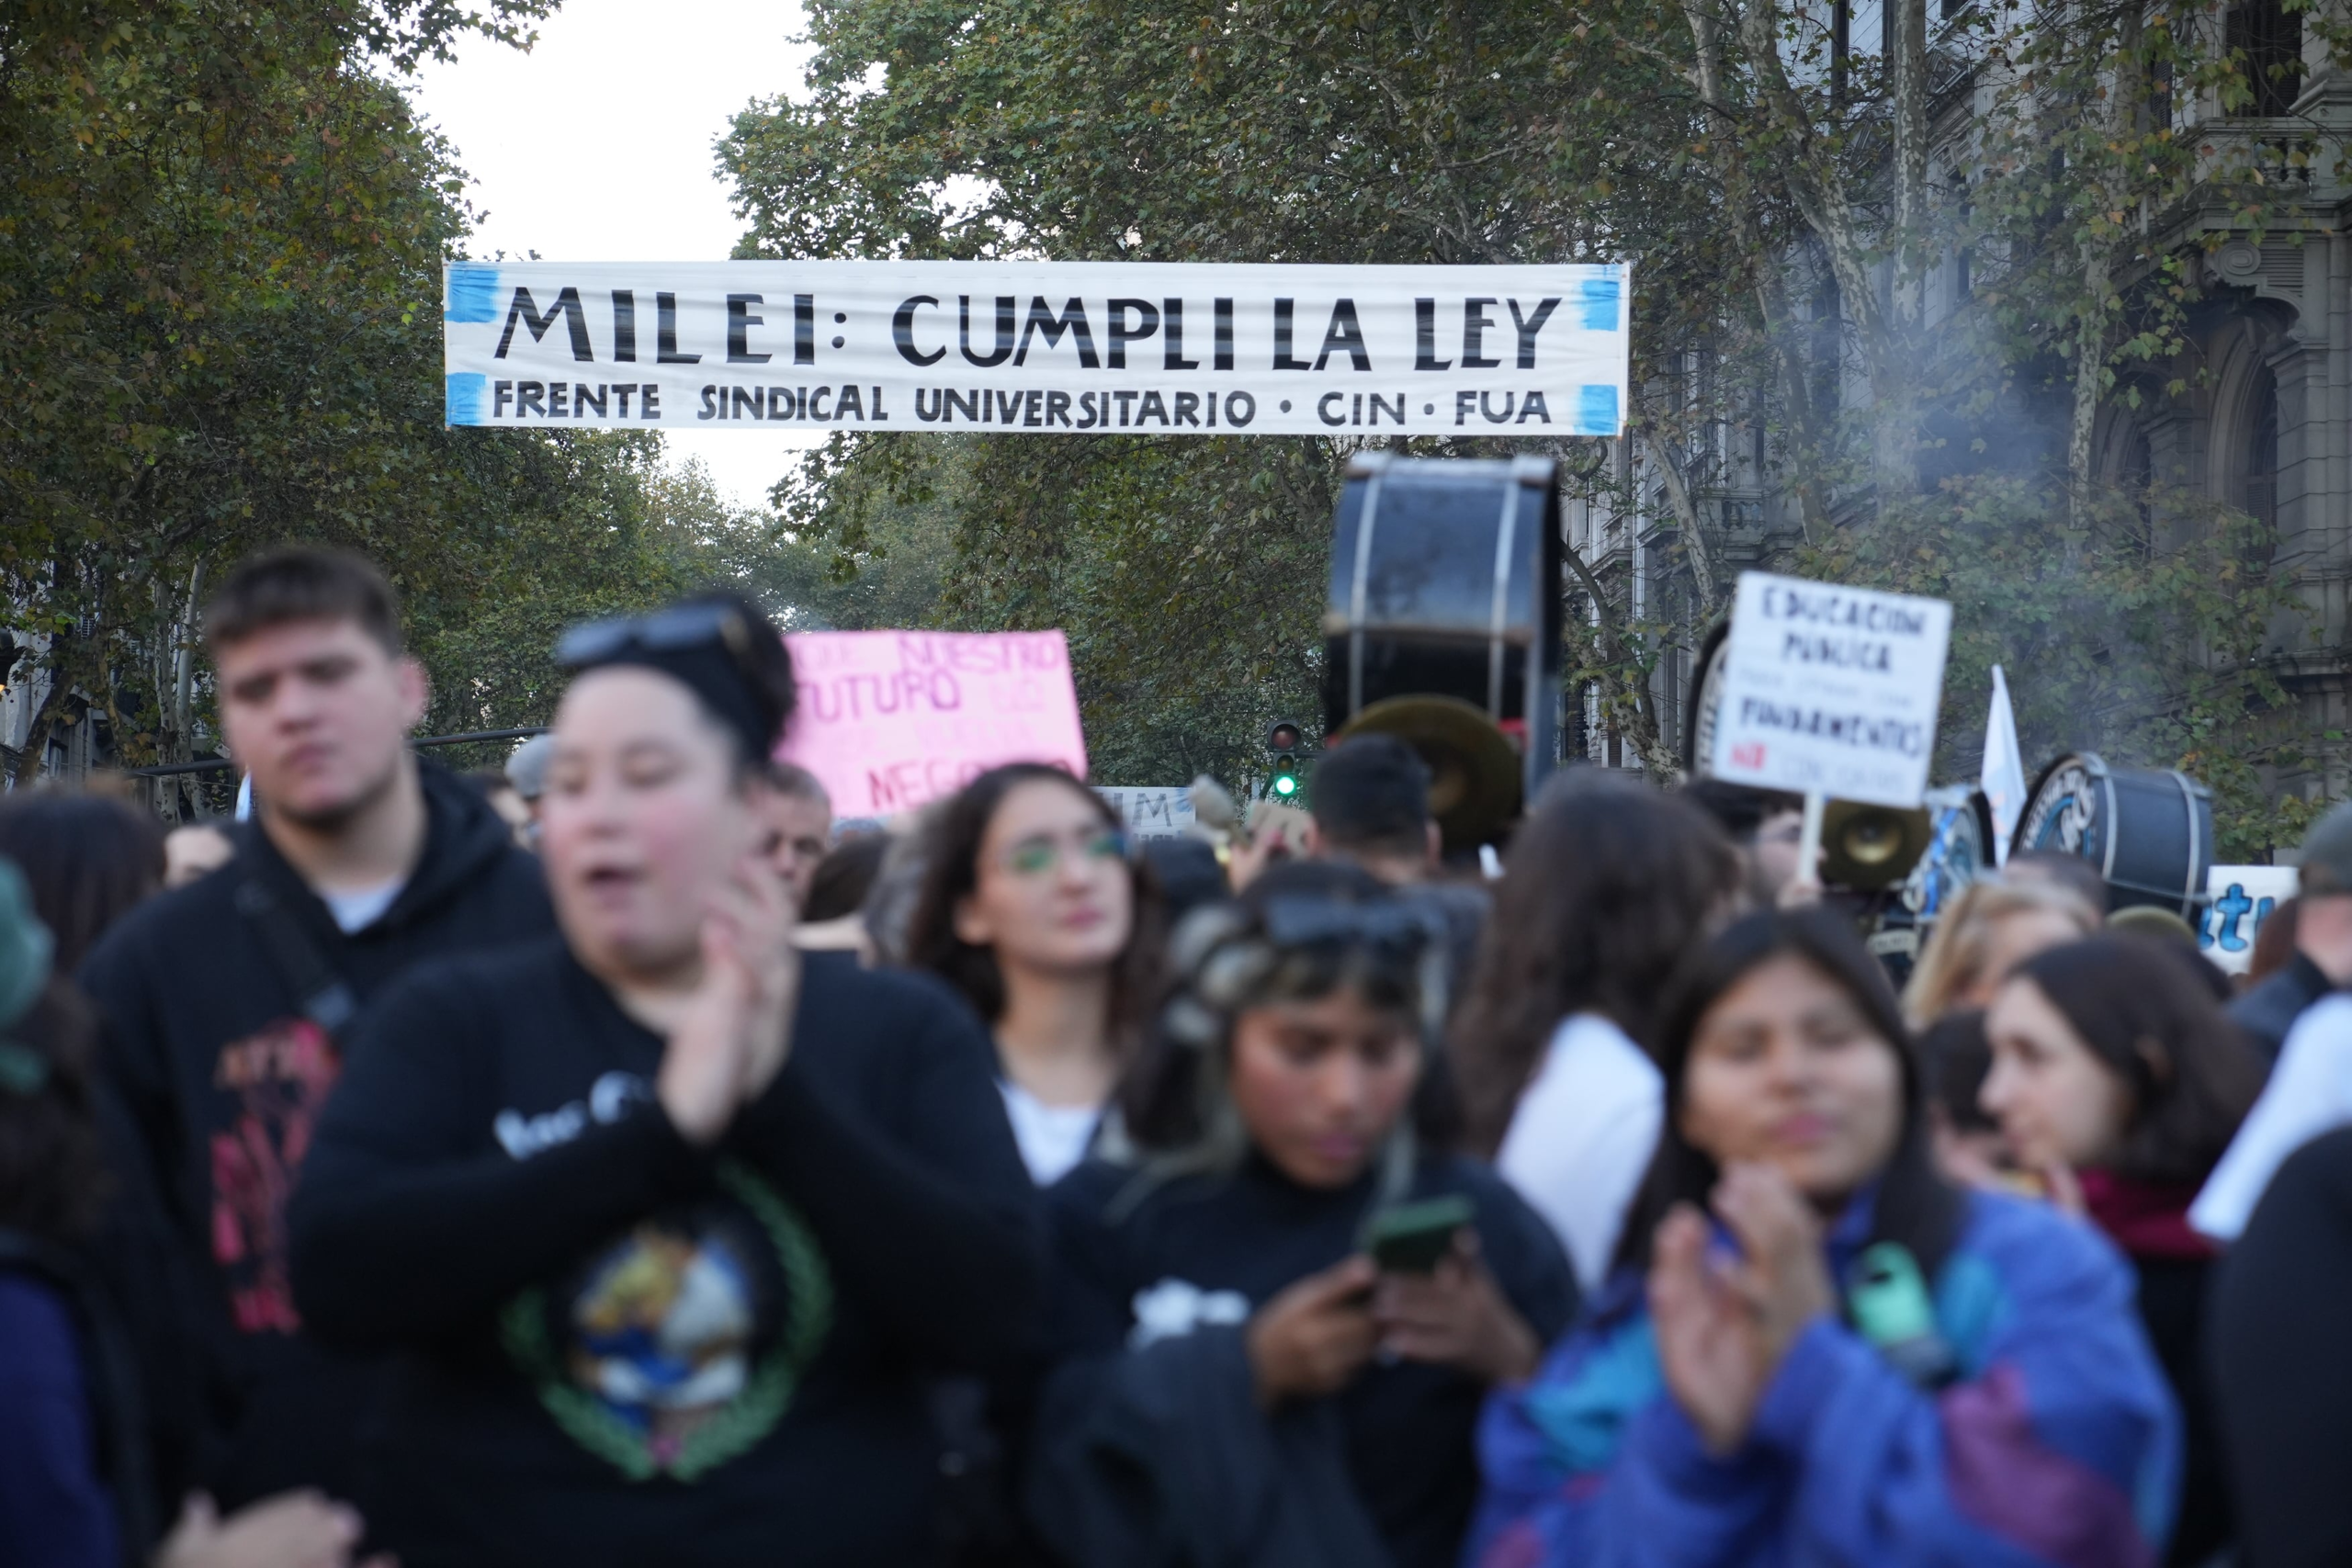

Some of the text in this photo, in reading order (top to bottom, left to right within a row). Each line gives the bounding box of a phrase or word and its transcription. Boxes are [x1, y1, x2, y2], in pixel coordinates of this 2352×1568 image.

[494, 287, 1561, 371] MILEI: CUMPLI LA LEY
[493, 380, 1551, 429] FRENTE SINDICAL UNIVERSITARIO CIN FUA
